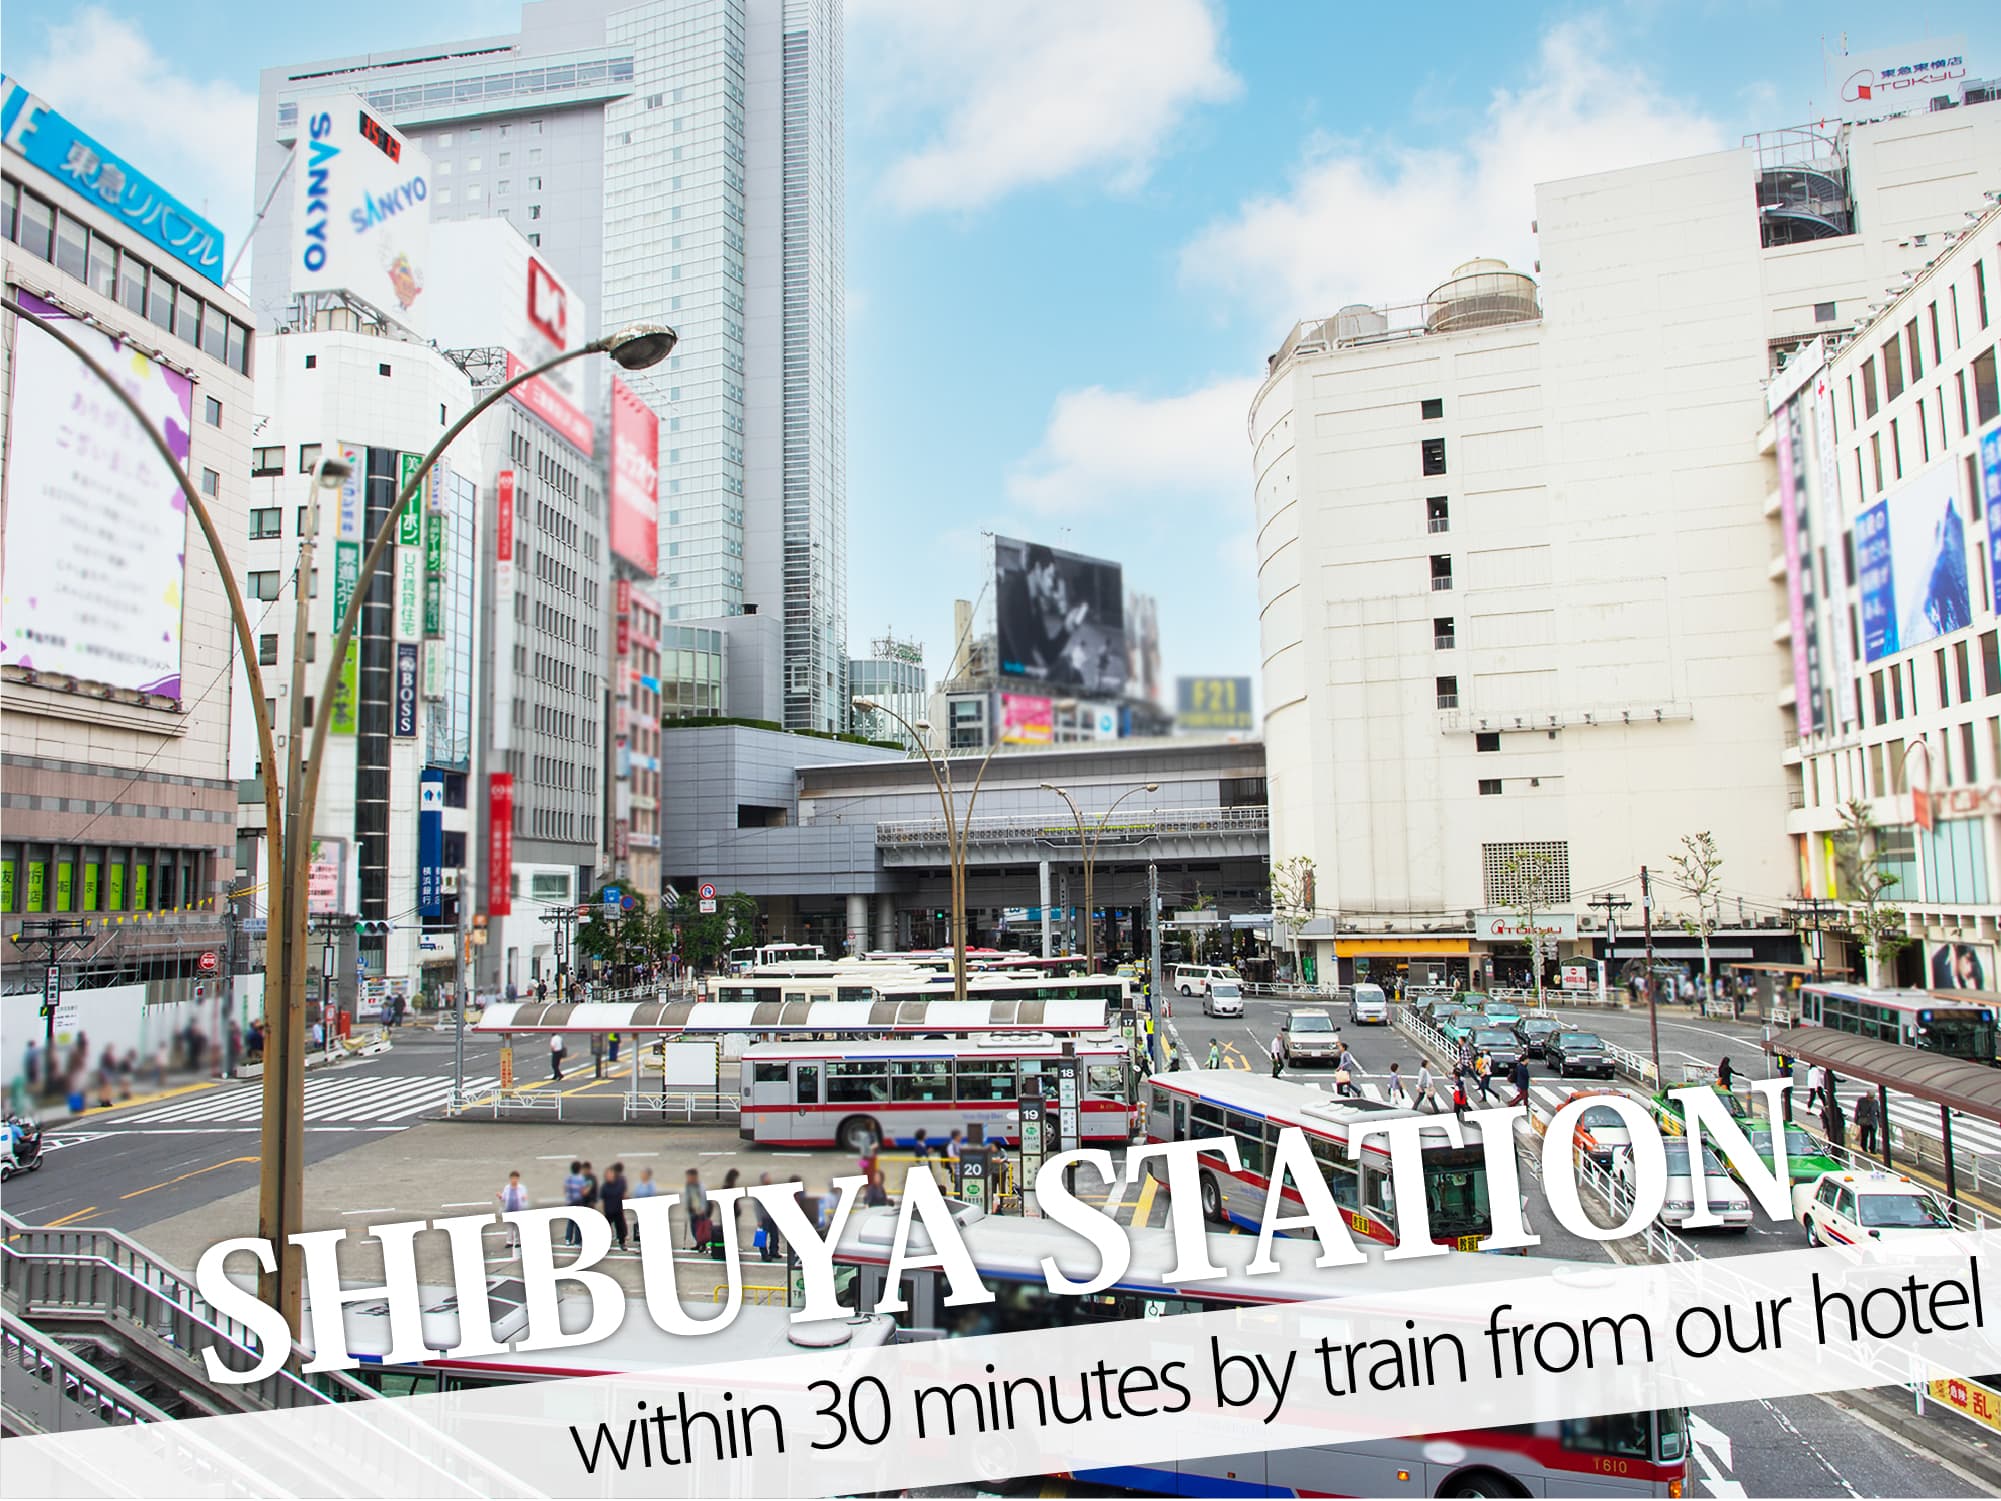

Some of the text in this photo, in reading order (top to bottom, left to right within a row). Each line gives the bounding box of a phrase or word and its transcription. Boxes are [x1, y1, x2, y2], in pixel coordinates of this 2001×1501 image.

[1881, 56, 1963, 79] 東急東横店
[1874, 68, 1966, 91] TOKYU
[60, 139, 219, 266] 東急リバブル
[304, 111, 341, 272] SANKYO
[350, 175, 427, 233] SANKYO
[400, 672, 414, 732] BOSS
[1193, 679, 1237, 711] F21
[1124, 1018, 1134, 1027] 17
[1061, 1068, 1074, 1078] 18
[1023, 1109, 1039, 1120] 19
[963, 1163, 982, 1176] 20
[1972, 1391, 1993, 1420] 乱
[1593, 1457, 1628, 1474] T610
